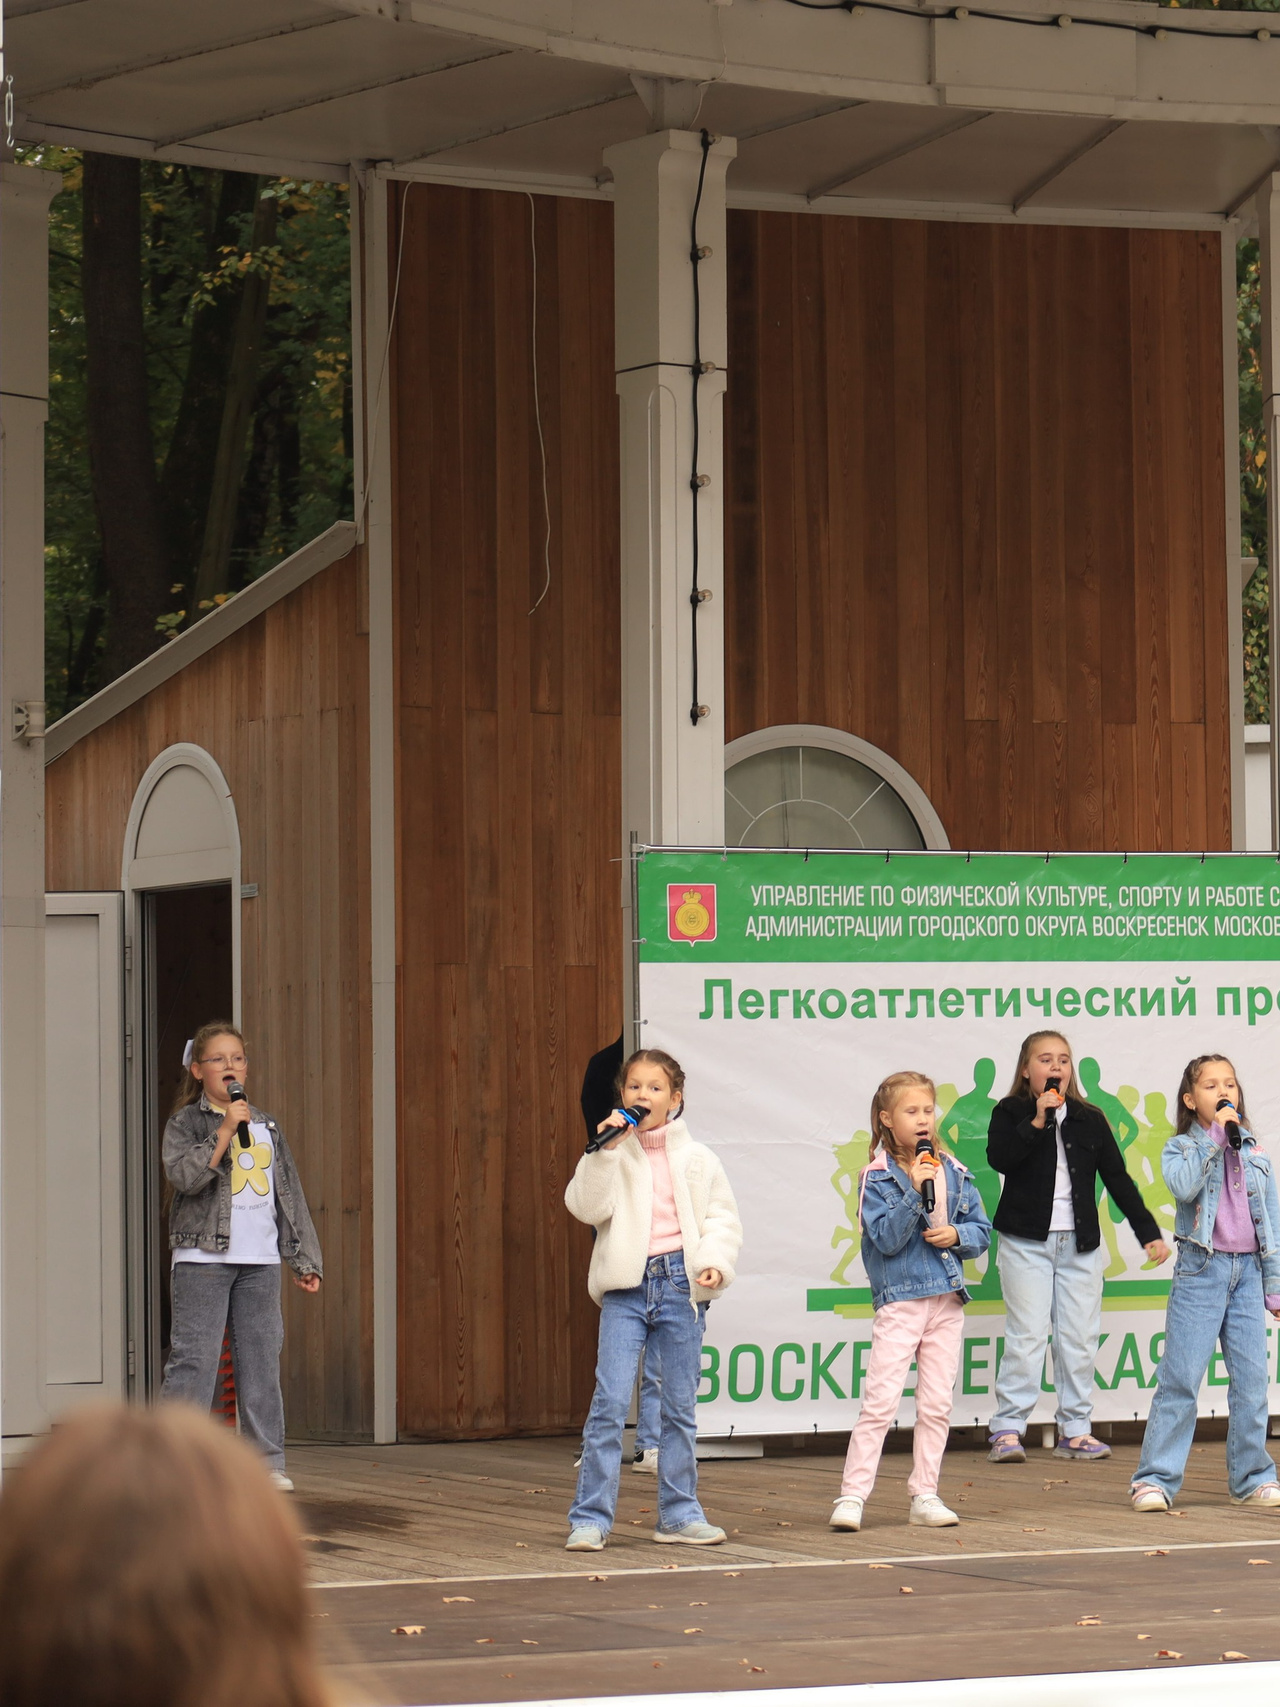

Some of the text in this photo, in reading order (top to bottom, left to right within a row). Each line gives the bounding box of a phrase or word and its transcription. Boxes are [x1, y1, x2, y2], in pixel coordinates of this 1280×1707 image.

[750, 884, 865, 907] УПРАВЛЕНИЕ
[870, 884, 895, 907] ПО
[900, 881, 1020, 907] ФИЗИЧЕСКОЙ
[1025, 885, 1112, 909] КУЛЬТУРЕ,
[1118, 885, 1183, 907] СПОРТУ
[1187, 885, 1200, 907] И
[1205, 885, 1265, 907] РАБОТЕ
[1269, 885, 1280, 907] С
[745, 915, 903, 941] АДМИНИСТРАЦИИ
[908, 915, 1019, 941] ГОРОДСКОГО
[1025, 915, 1088, 937] ОКРУГА
[1092, 915, 1210, 937] ВОСКРЕСЕНСК
[699, 976, 1197, 1020] Легкоатлетический
